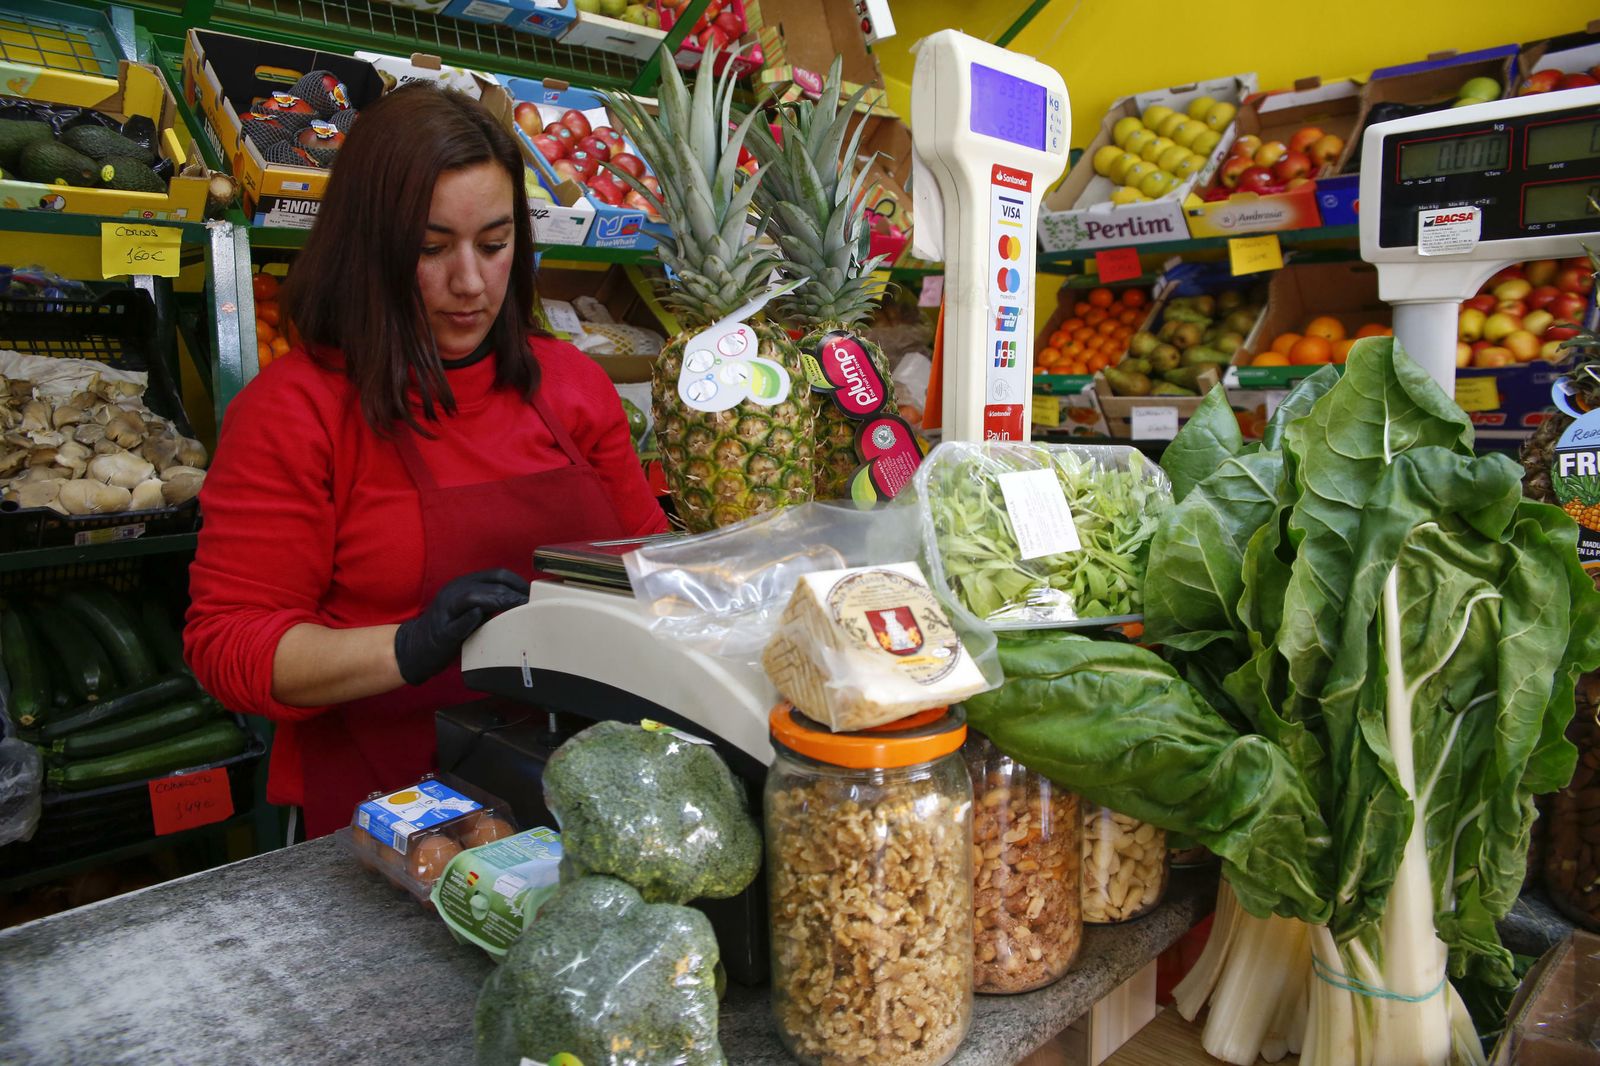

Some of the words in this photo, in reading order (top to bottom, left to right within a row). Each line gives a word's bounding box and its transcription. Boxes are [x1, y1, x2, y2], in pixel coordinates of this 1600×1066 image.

[1048, 95, 1060, 111] kg
[1493, 123, 1505, 131] kg
[1003, 173, 1028, 187] Santander
[271, 199, 321, 215] RUNET
[1002, 204, 1021, 220] VISA
[1434, 212, 1474, 224] BACSA
[1085, 216, 1174, 240] Perlim
[595, 238, 636, 248] BlueWhale
[994, 349, 1016, 360] JCB
[834, 348, 879, 406] plump
[987, 430, 1001, 441] Pay
[1001, 429, 1010, 441] in
